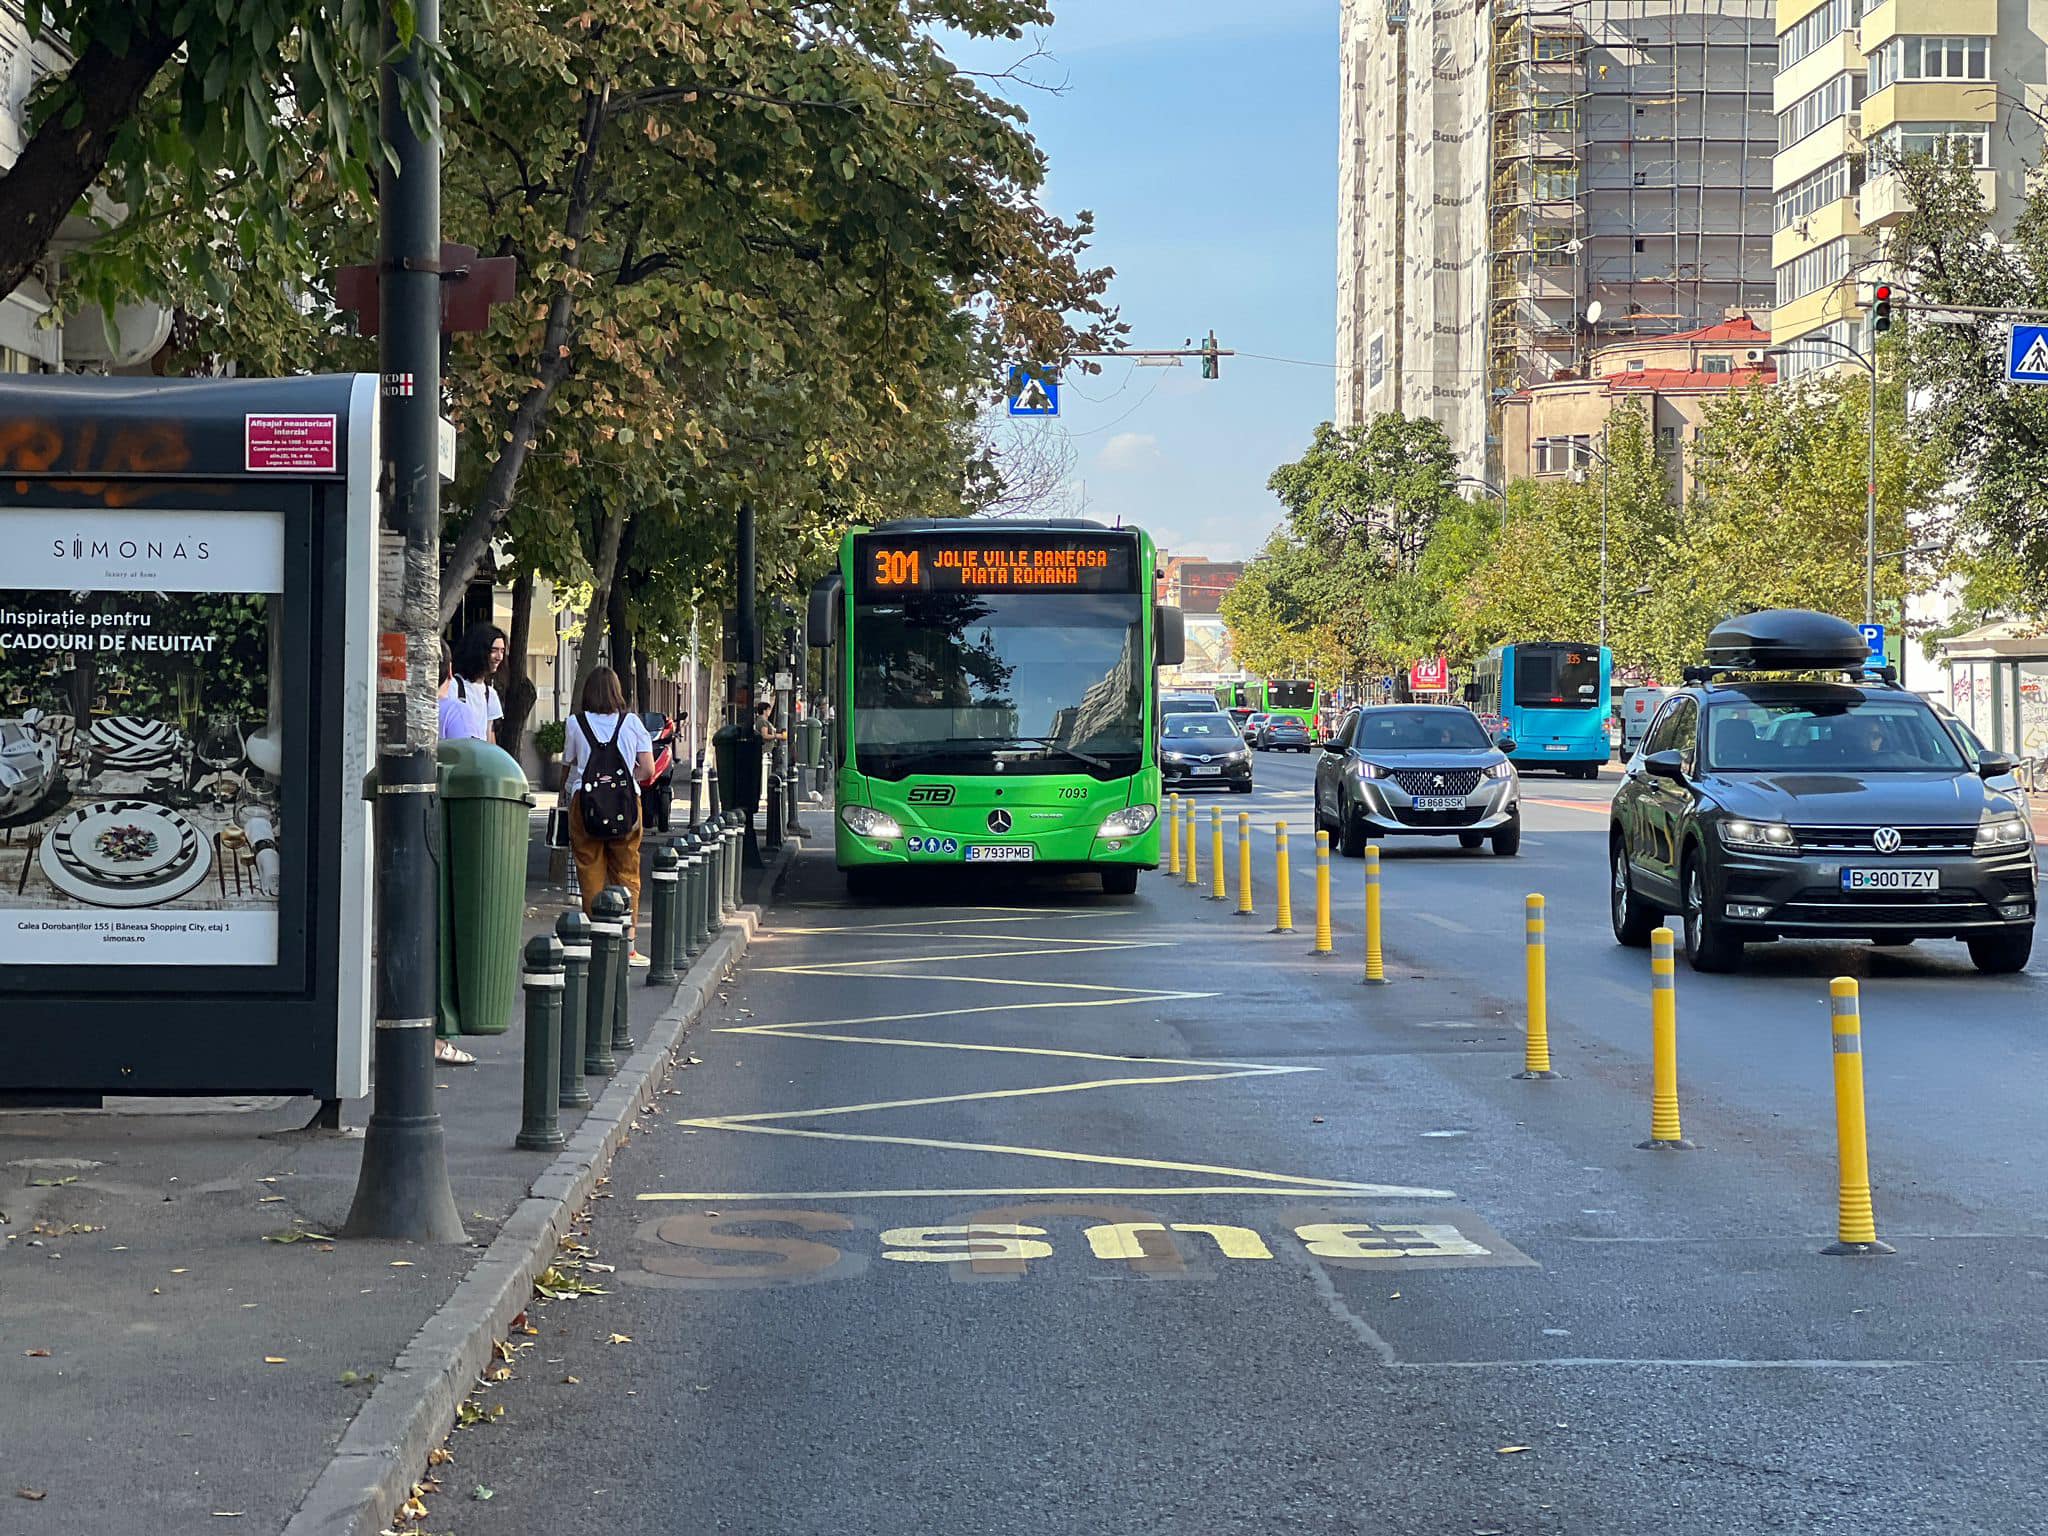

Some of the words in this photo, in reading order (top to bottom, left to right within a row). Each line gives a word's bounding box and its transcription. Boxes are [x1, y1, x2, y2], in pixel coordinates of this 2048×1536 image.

[933, 551, 978, 567] JOLIE
[984, 551, 1028, 567] VILLE
[1034, 551, 1107, 567] BANEASA
[875, 551, 919, 584] 301
[961, 568, 1008, 584] PIATA
[1013, 568, 1077, 584] ROMANA
[0, 609, 85, 628] Inspirație
[91, 611, 150, 628] pentru
[0, 633, 93, 650] CADOURI
[100, 635, 126, 650] DE
[131, 635, 216, 651] NEUITAT
[1864, 628, 1878, 647] P
[907, 788, 950, 802] STB
[1058, 787, 1088, 800] 7093
[1870, 872, 1899, 887] 900
[1901, 872, 1934, 887] TZY
[18, 922, 40, 930] Calea
[150, 922, 187, 933] Shopping
[188, 923, 207, 933] City,
[208, 923, 224, 933] etaj
[103, 934, 145, 943] simonas.ro
